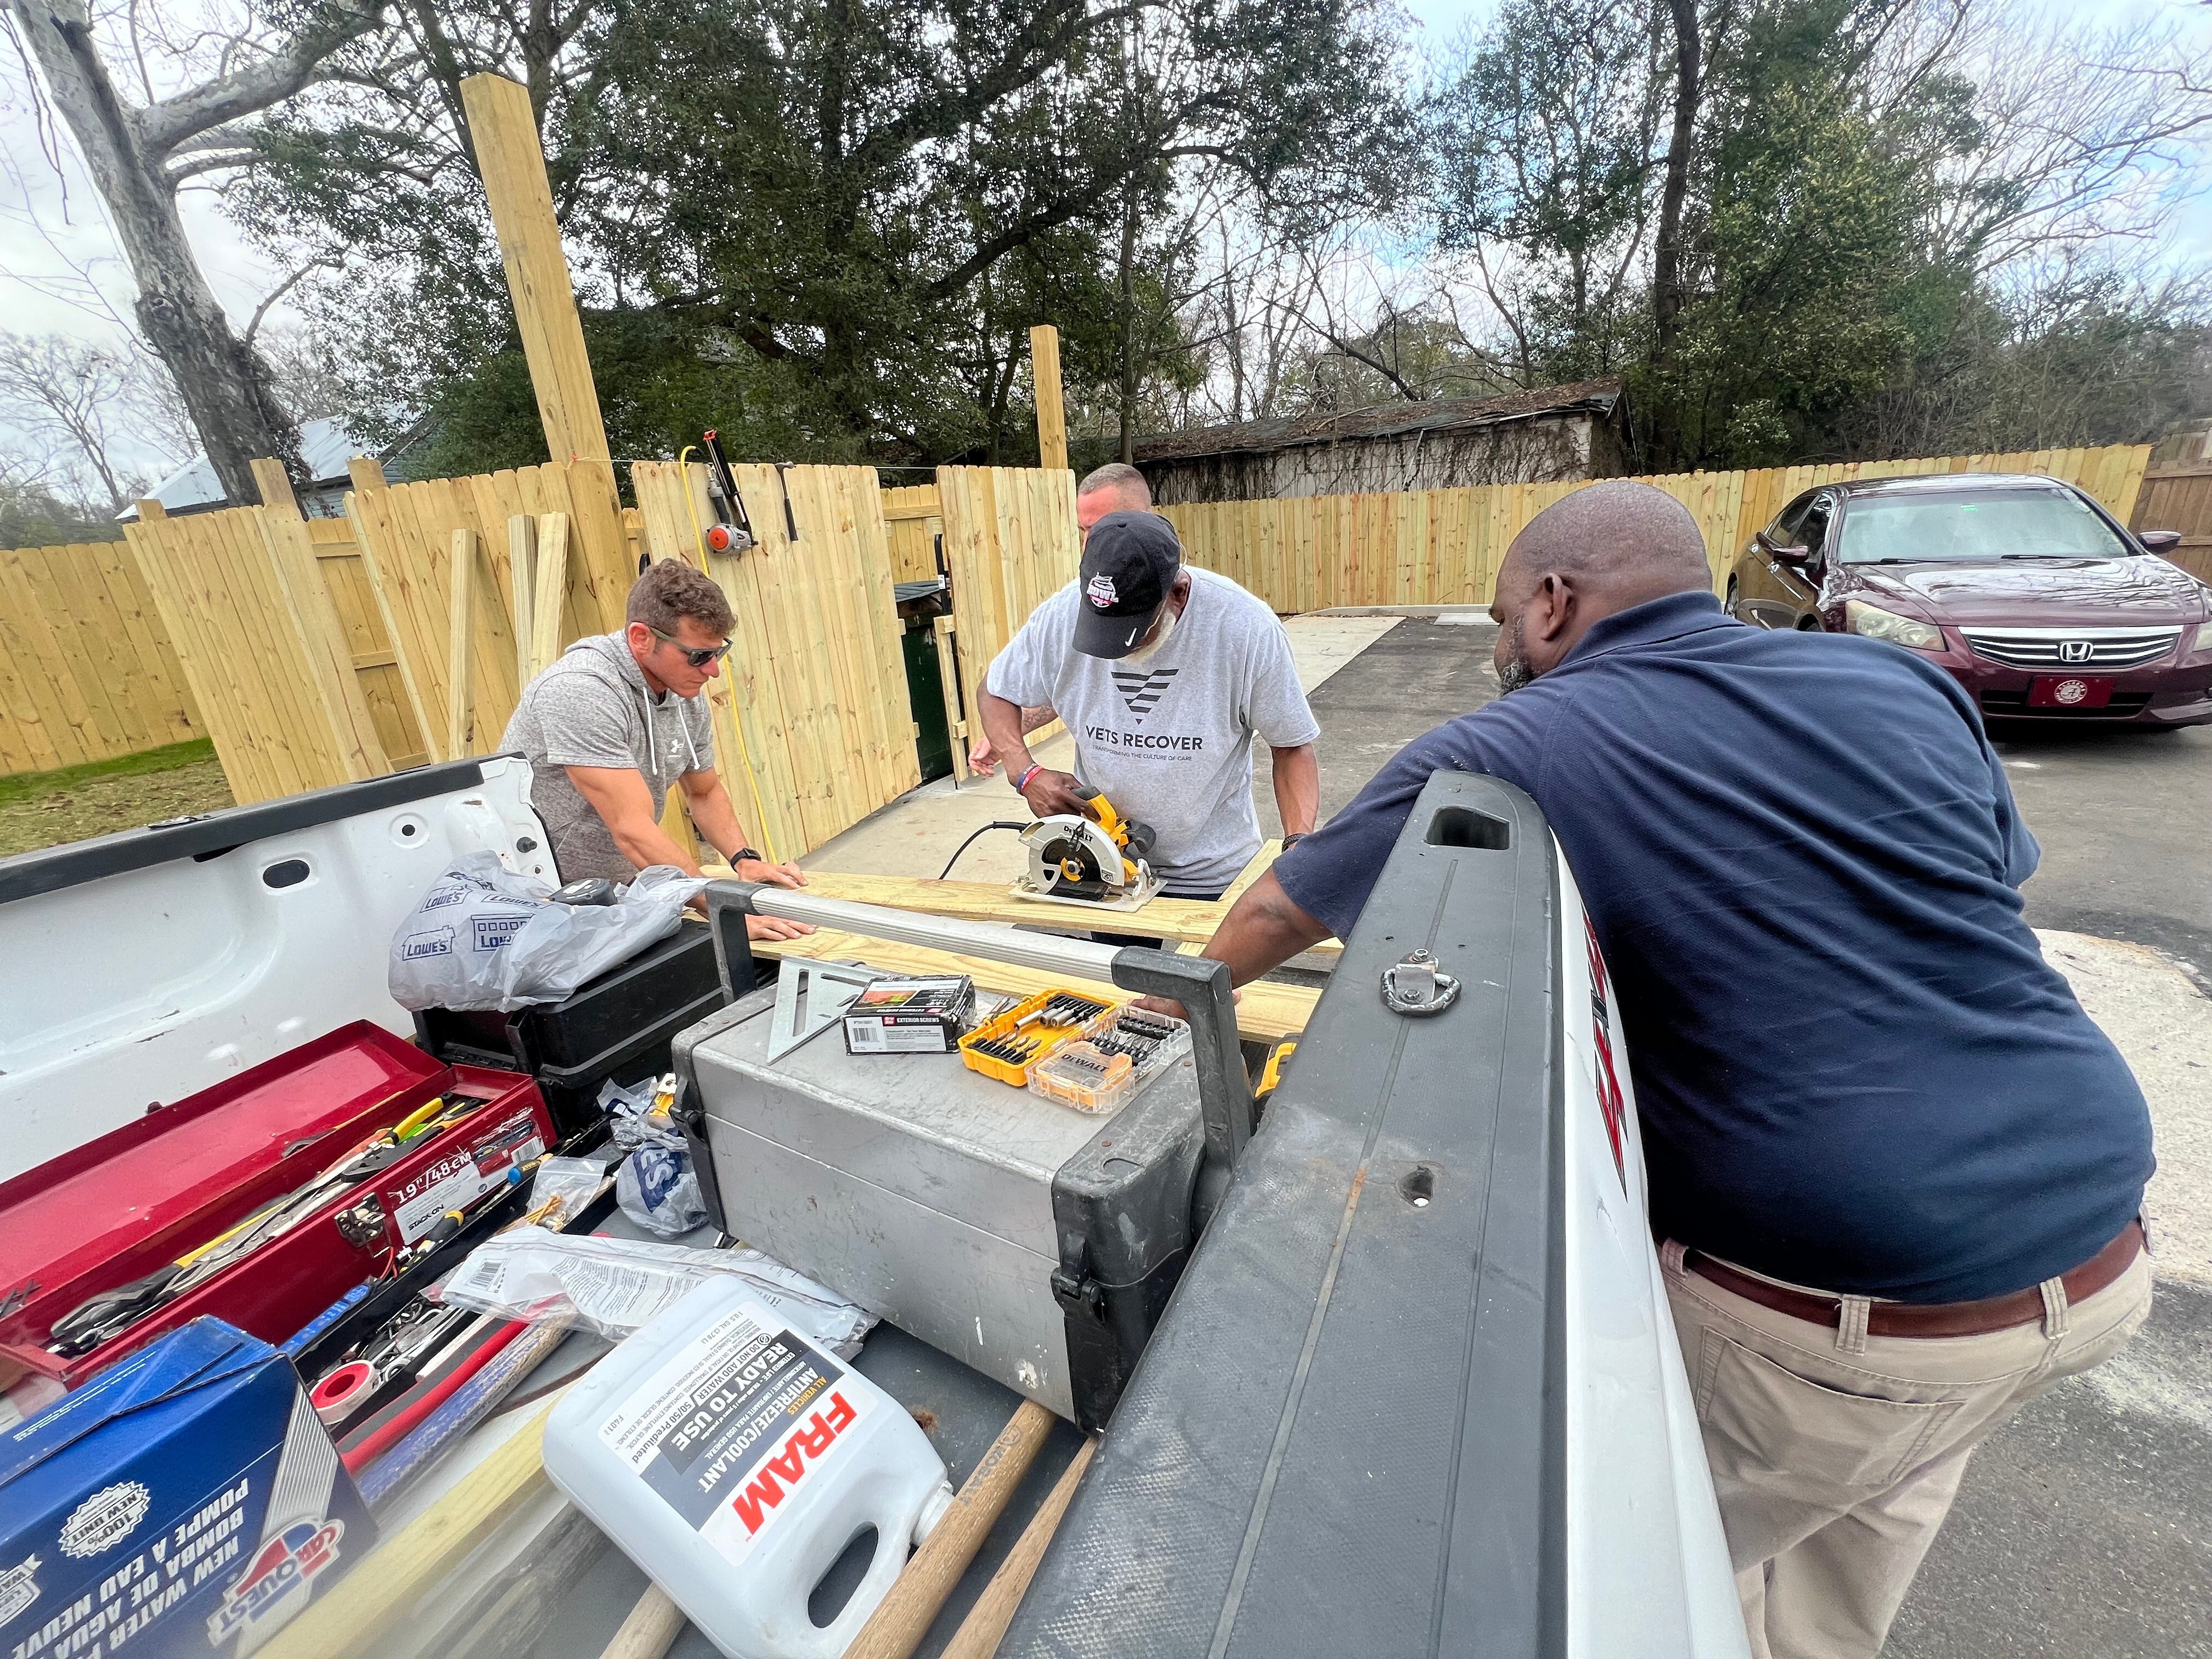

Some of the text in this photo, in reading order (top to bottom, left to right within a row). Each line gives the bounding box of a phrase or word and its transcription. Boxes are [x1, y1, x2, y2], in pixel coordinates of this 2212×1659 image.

[1086, 725, 1203, 750] VETS RECOVER
[1093, 745, 1130, 757] TRANSFORMING
[425, 891, 464, 909] LOWE'S
[489, 895, 543, 906] LOWE'S
[407, 939, 448, 956] LOWE'S
[1060, 1053, 1109, 1072] DEWALT
[719, 1319, 731, 1330] GAL
[729, 1313, 740, 1323] U.S.
[697, 1343, 760, 1401] DO NOT ADD WATER
[761, 1369, 775, 1381] LIFE
[771, 1351, 796, 1373] EXTENDED
[663, 1392, 685, 1412] CONTAINS
[670, 1341, 788, 1452] READY TO USE
[787, 1376, 827, 1415] ALL VEHICLES
[631, 1401, 692, 1464] 50/50 Prediluted
[634, 1418, 642, 1426] DE
[696, 1366, 820, 1493] ANTIFREEZE/COOLANT
[725, 1426, 738, 1438] USO
[735, 1414, 751, 1429] PARA
[704, 1435, 729, 1461] GENERAL
[732, 1391, 857, 1536] FRAM
[108, 1493, 137, 1519] NEW
[174, 1477, 249, 1548] POMPE
[72, 1516, 105, 1543] UNIT
[88, 1512, 134, 1547] 100%
[166, 1506, 244, 1578] BOMBA
[100, 1554, 144, 1603] EAU
[130, 1571, 159, 1608] DE
[219, 1526, 337, 1633] CARQUEST
[110, 1536, 239, 1651] NEW WATER
[12, 1593, 91, 1659] NEUVE
[55, 1597, 121, 1659] AGUA
